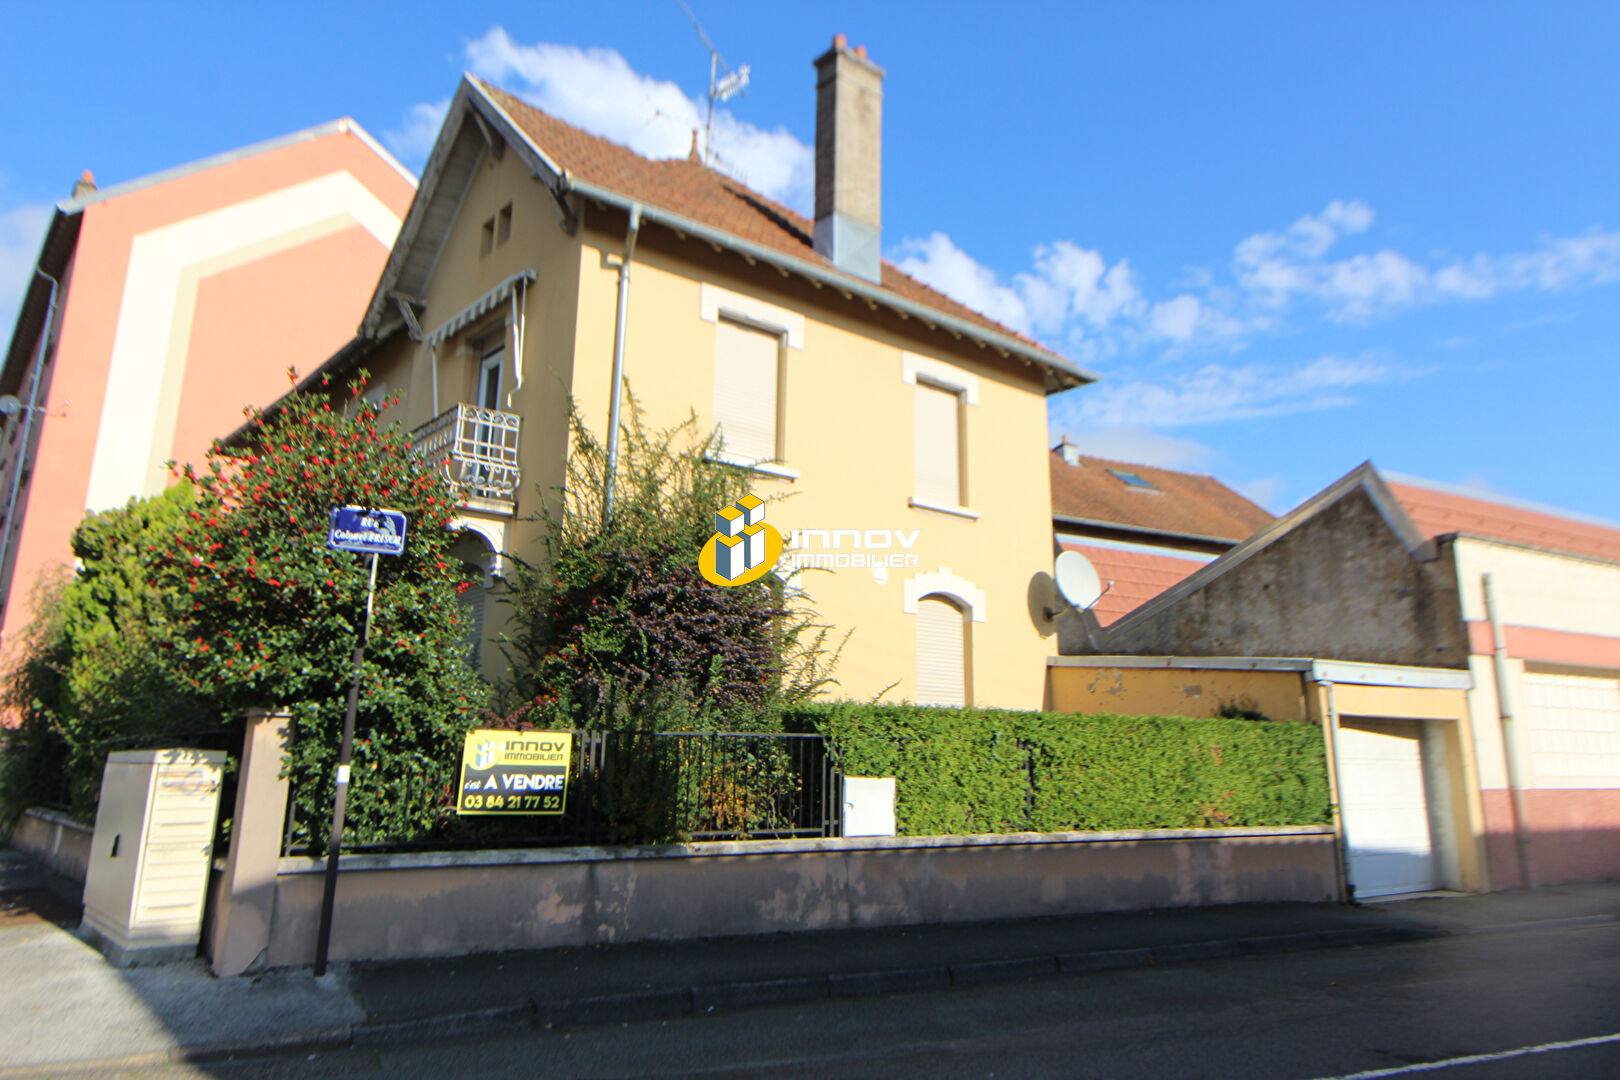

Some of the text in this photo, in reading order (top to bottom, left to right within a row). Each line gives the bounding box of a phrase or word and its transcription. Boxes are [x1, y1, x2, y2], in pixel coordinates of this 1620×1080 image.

[504, 752, 564, 761] IMMOBILIER
[483, 773, 498, 790] A
[501, 773, 565, 791] VENDRE
[464, 794, 560, 809] 03 84 21 77 52
